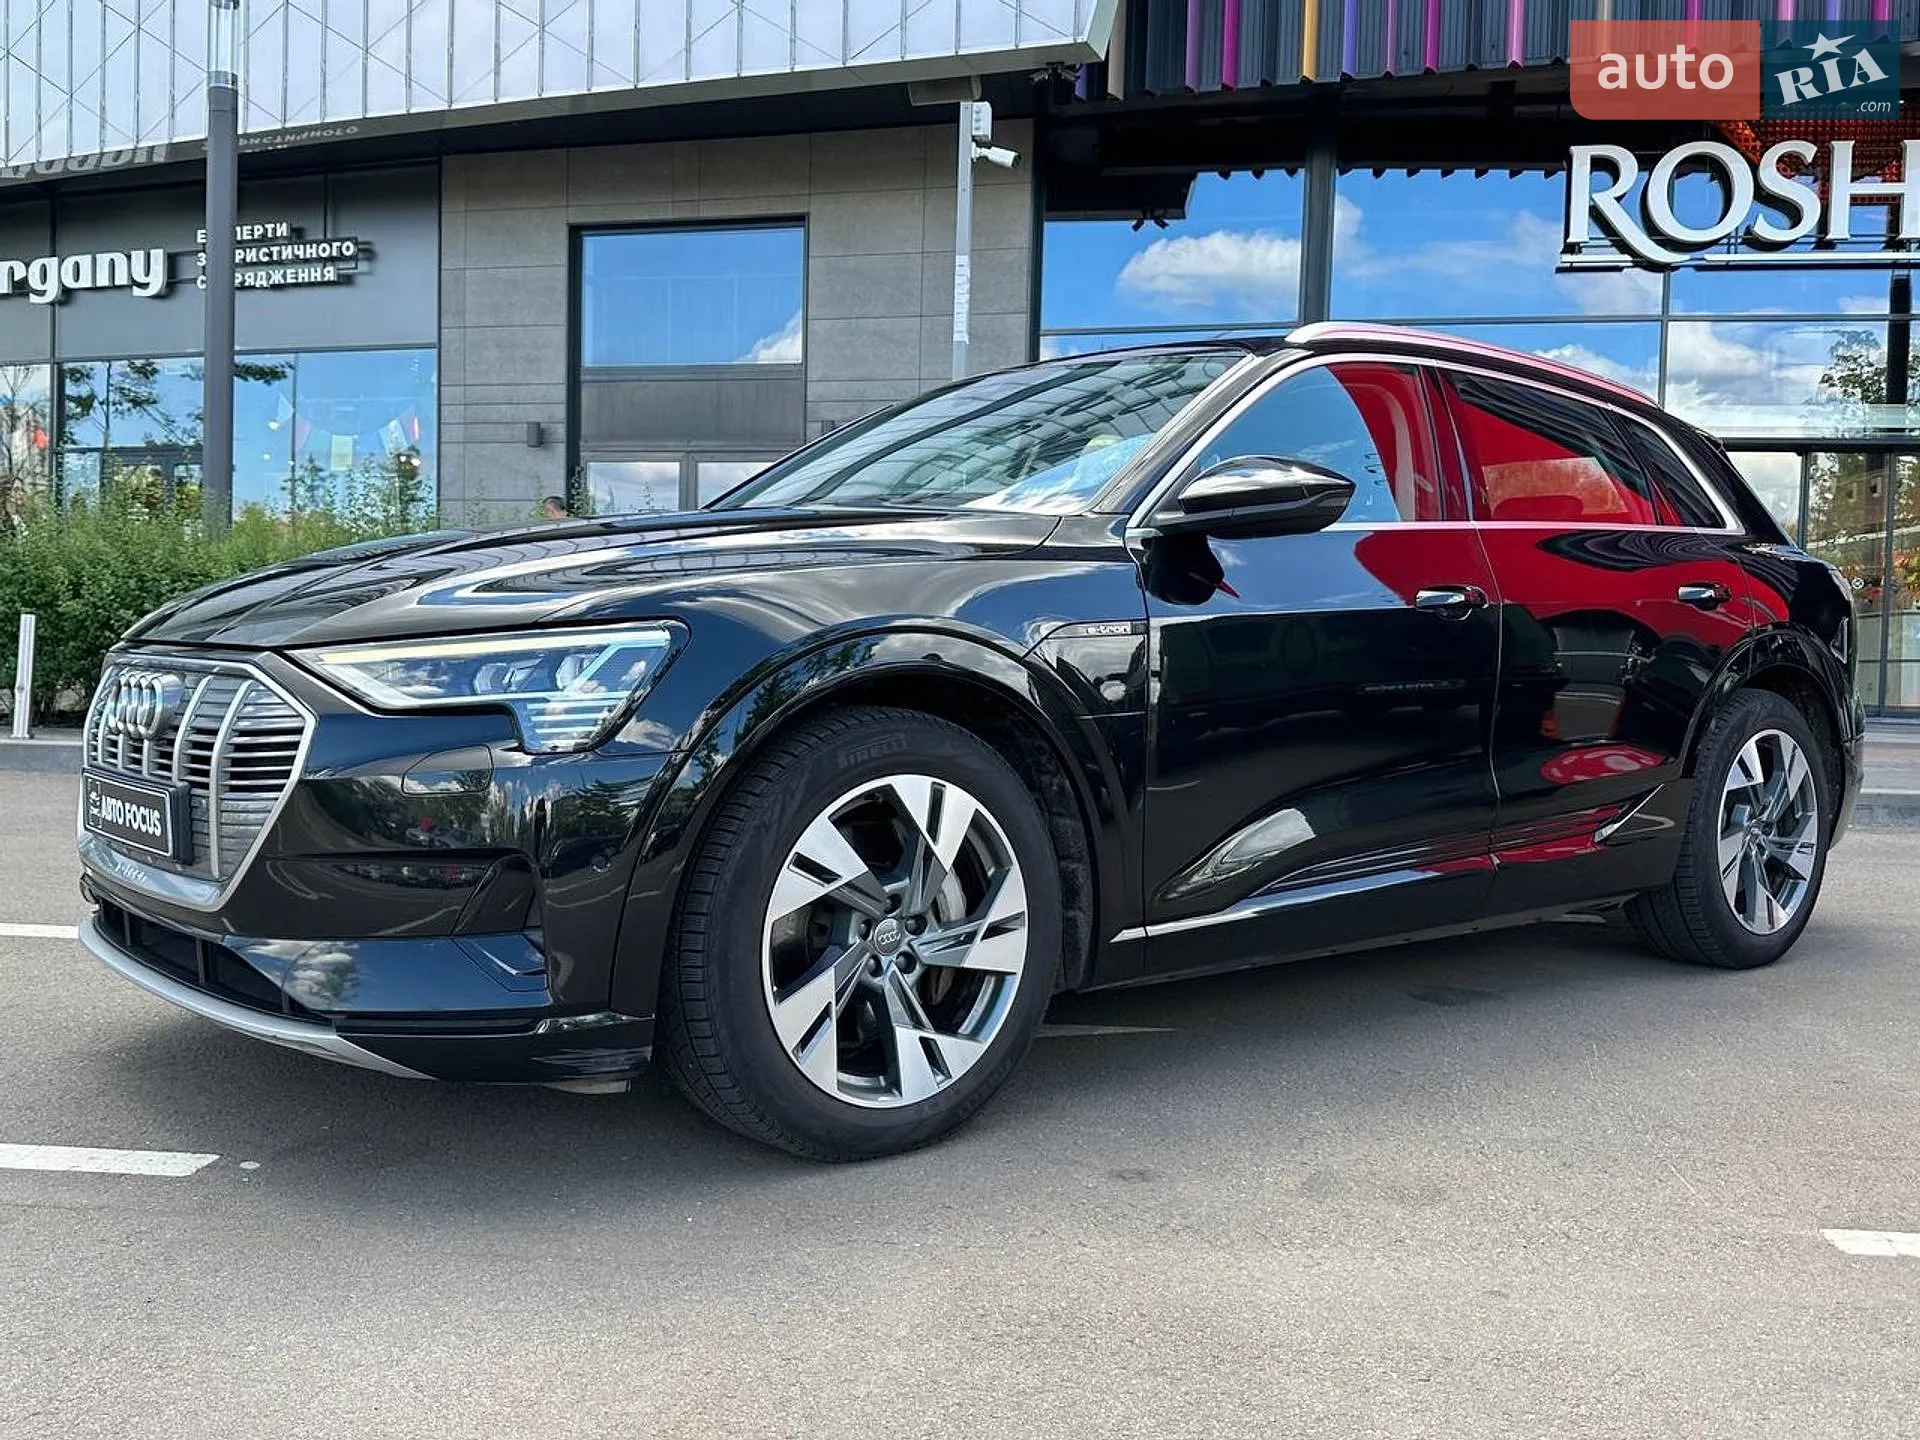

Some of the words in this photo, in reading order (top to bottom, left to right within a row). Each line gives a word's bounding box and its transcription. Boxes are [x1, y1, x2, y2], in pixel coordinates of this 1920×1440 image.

[1566, 139, 1920, 265] ROSH
[0, 248, 165, 304] rgany
[196, 266, 336, 289] СРЯДЖЕННЯ
[124, 802, 162, 837] FOCUS
